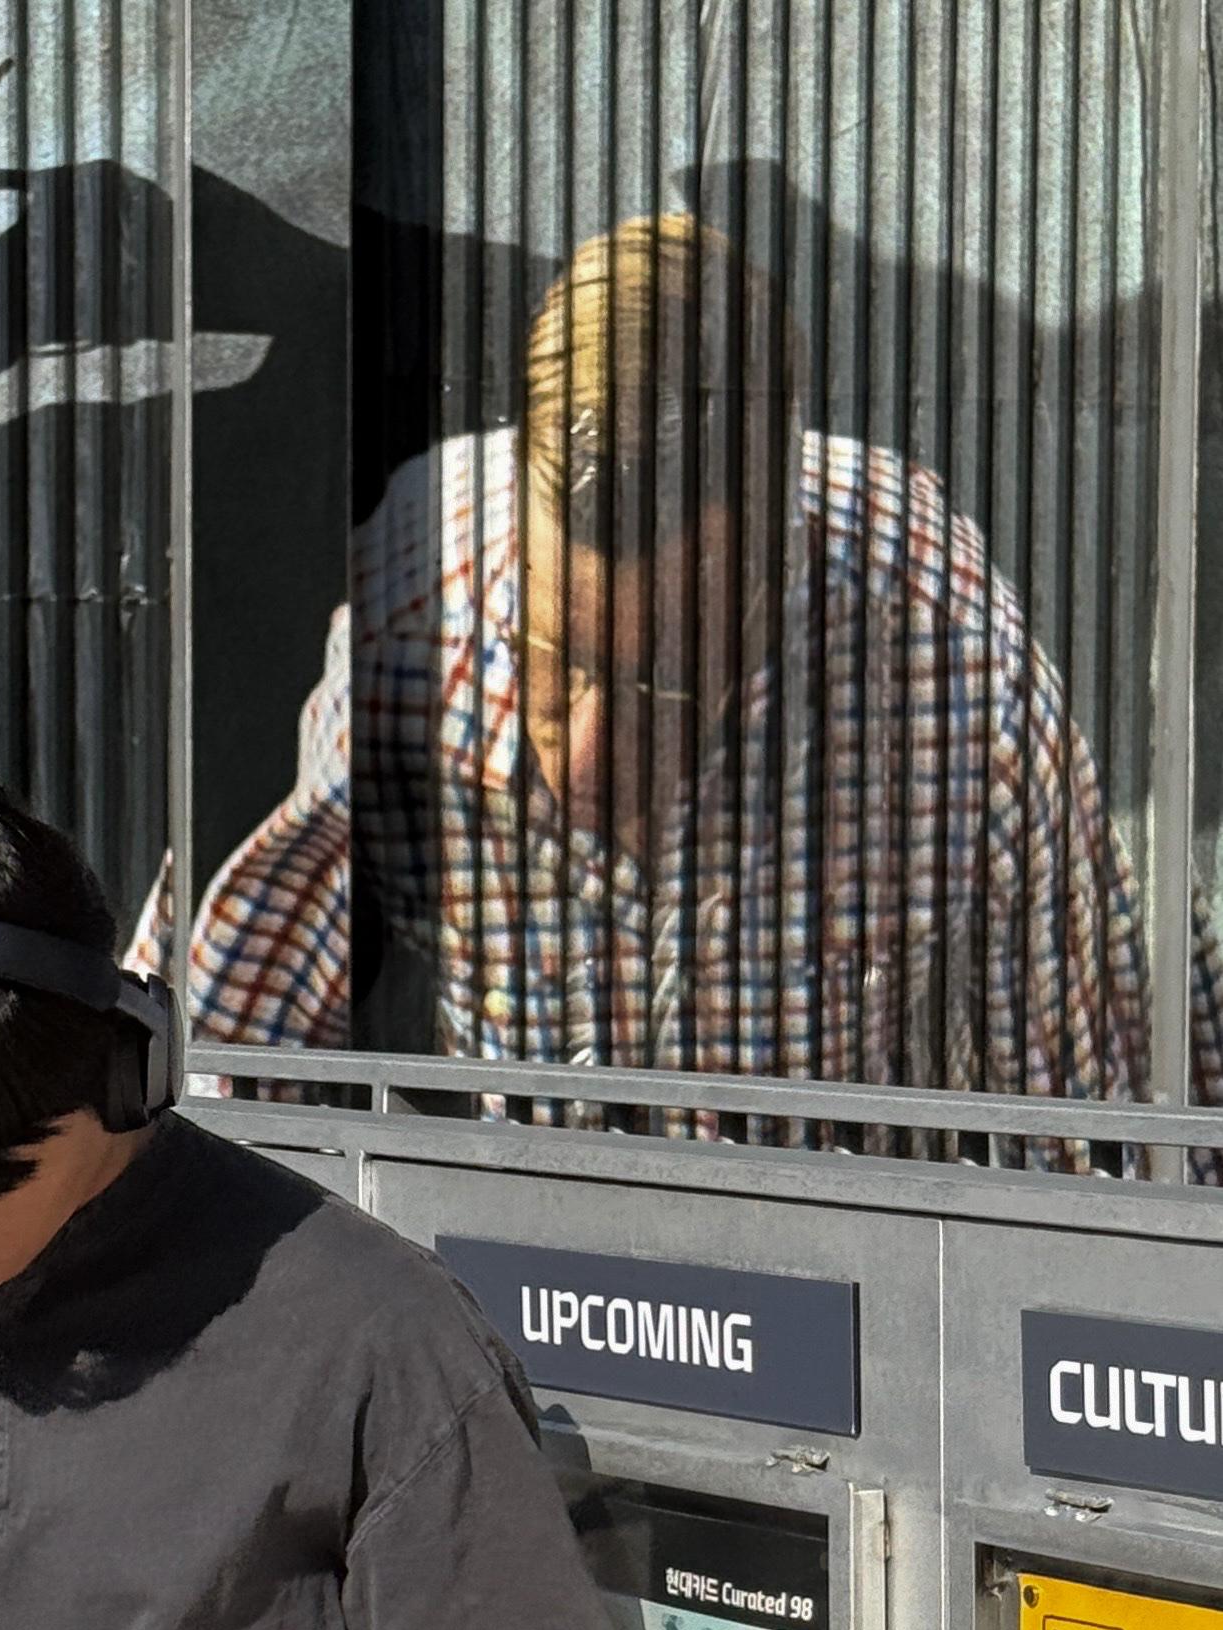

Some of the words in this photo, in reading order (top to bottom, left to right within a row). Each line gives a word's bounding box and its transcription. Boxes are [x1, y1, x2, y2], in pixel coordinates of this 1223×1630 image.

[521, 1285, 755, 1373] UPCOMING
[1049, 1359, 1223, 1446] CULTU
[665, 1567, 719, 1603] 현대카드
[722, 1582, 786, 1617] Curated
[790, 1596, 813, 1621] 98
